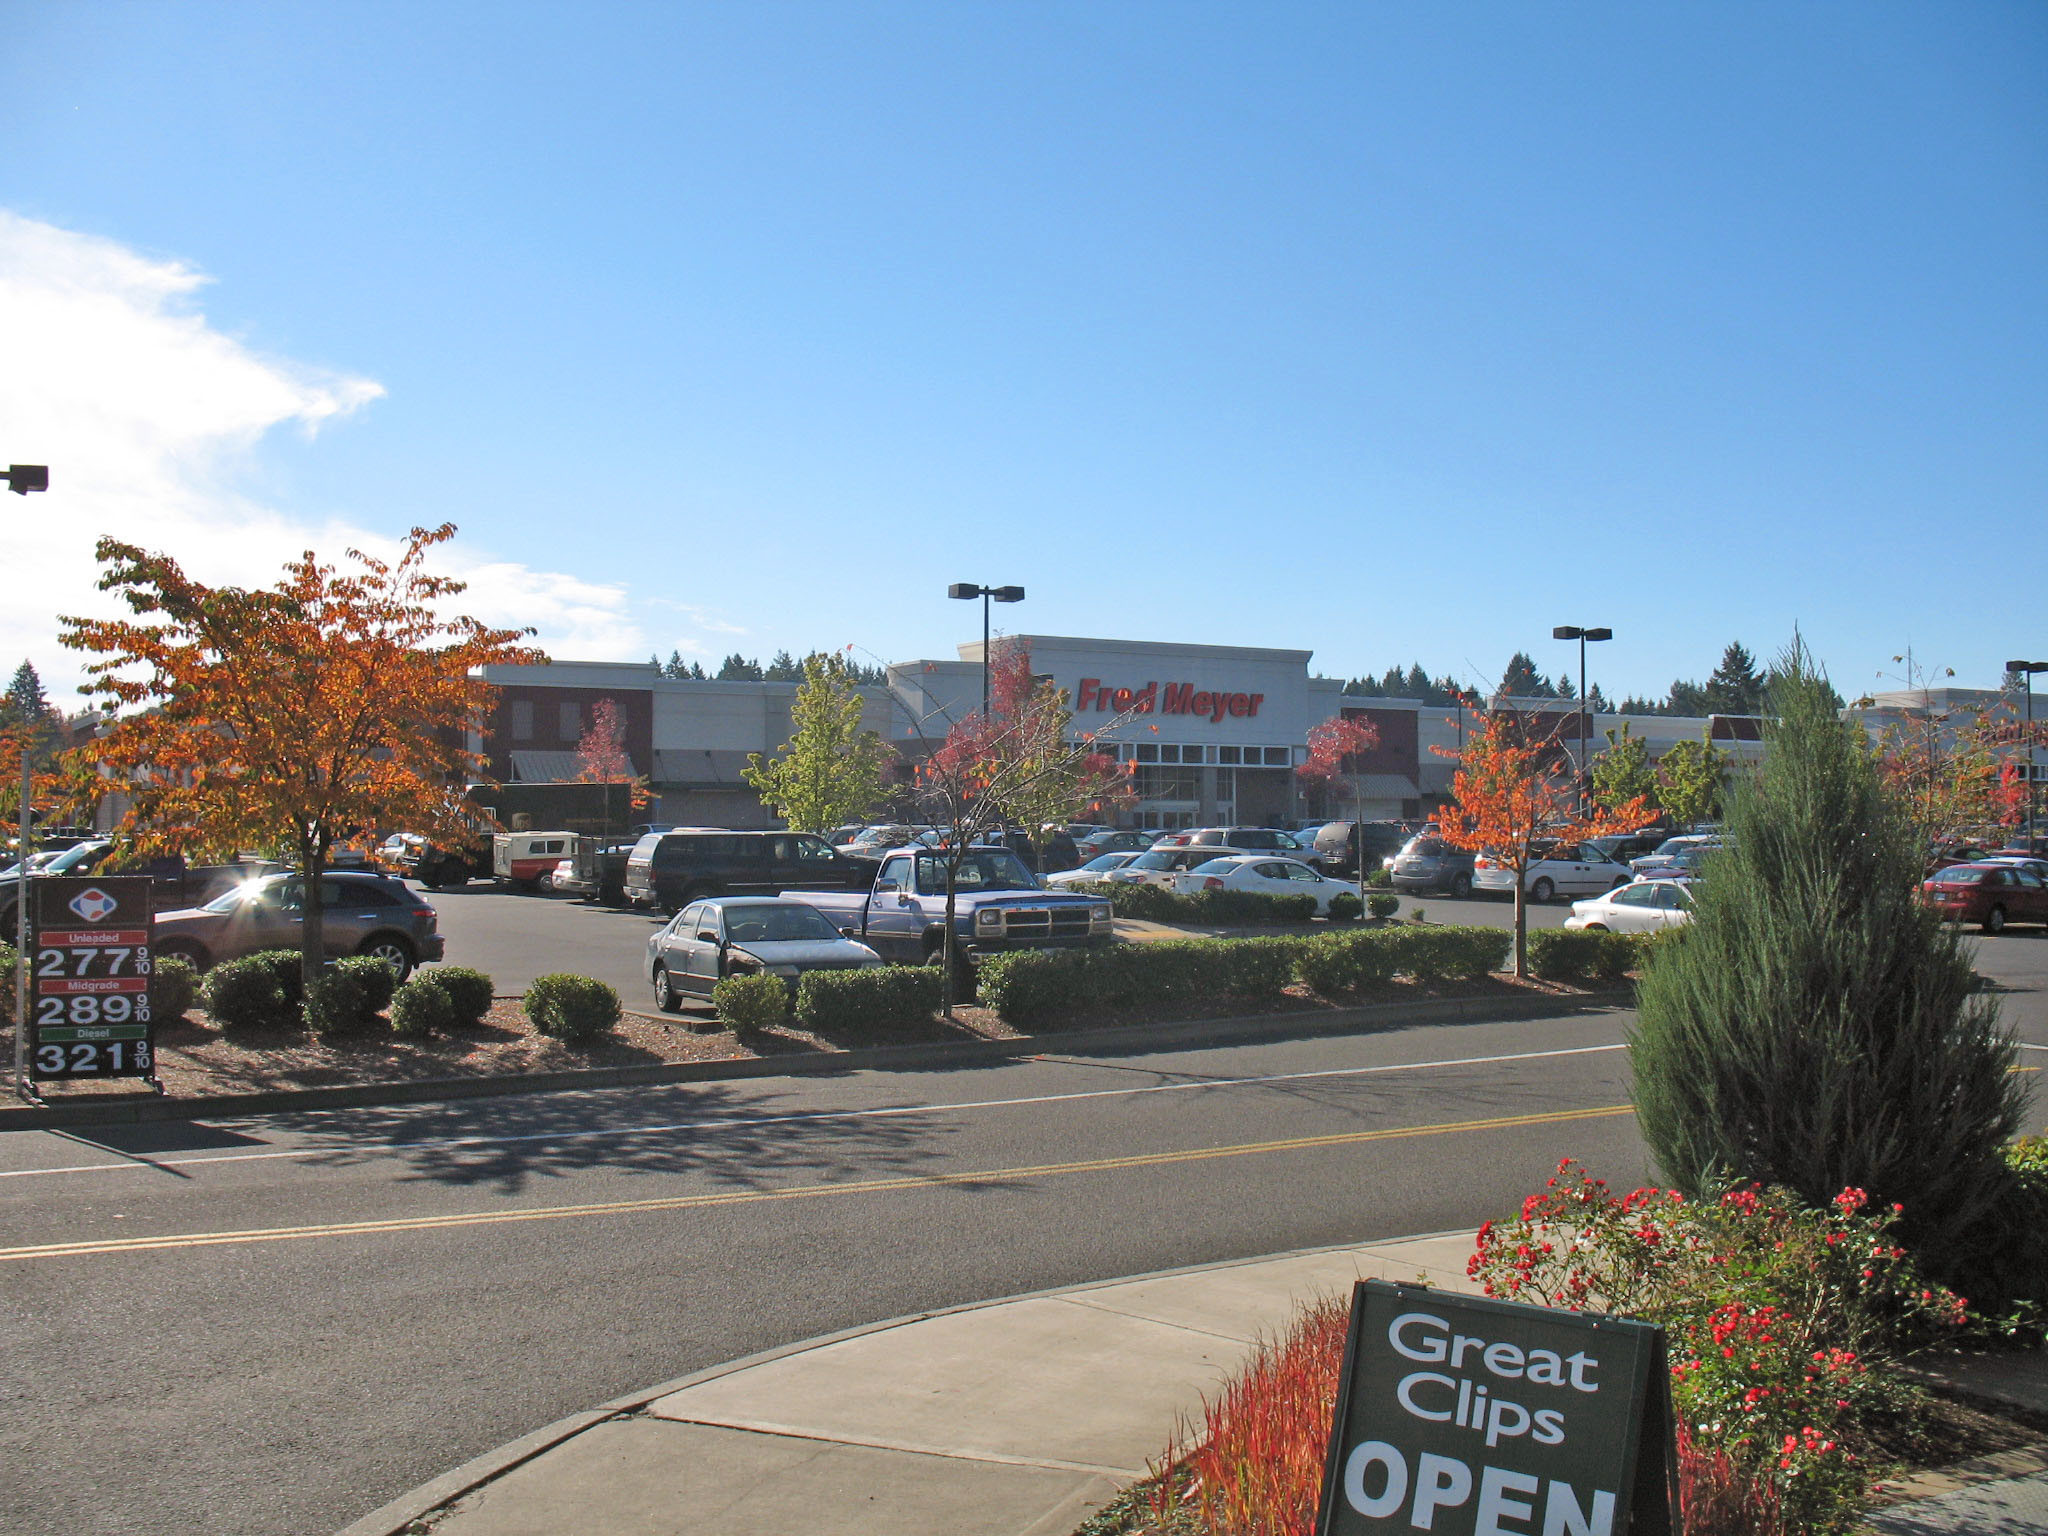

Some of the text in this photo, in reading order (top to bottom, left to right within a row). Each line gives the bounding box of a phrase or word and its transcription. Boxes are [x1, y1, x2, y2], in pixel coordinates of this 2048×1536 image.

[1077, 678, 1264, 723] Fred Meyer
[69, 933, 119, 944] Unleaded
[37, 948, 131, 977] 277
[68, 980, 120, 991] Midgrade
[37, 995, 131, 1025] 289
[77, 1028, 110, 1038] Diesel
[37, 1042, 123, 1072] 321
[1388, 1312, 1599, 1392] Great
[1397, 1371, 1565, 1448] Clips
[1344, 1440, 1616, 1536] OPEN
